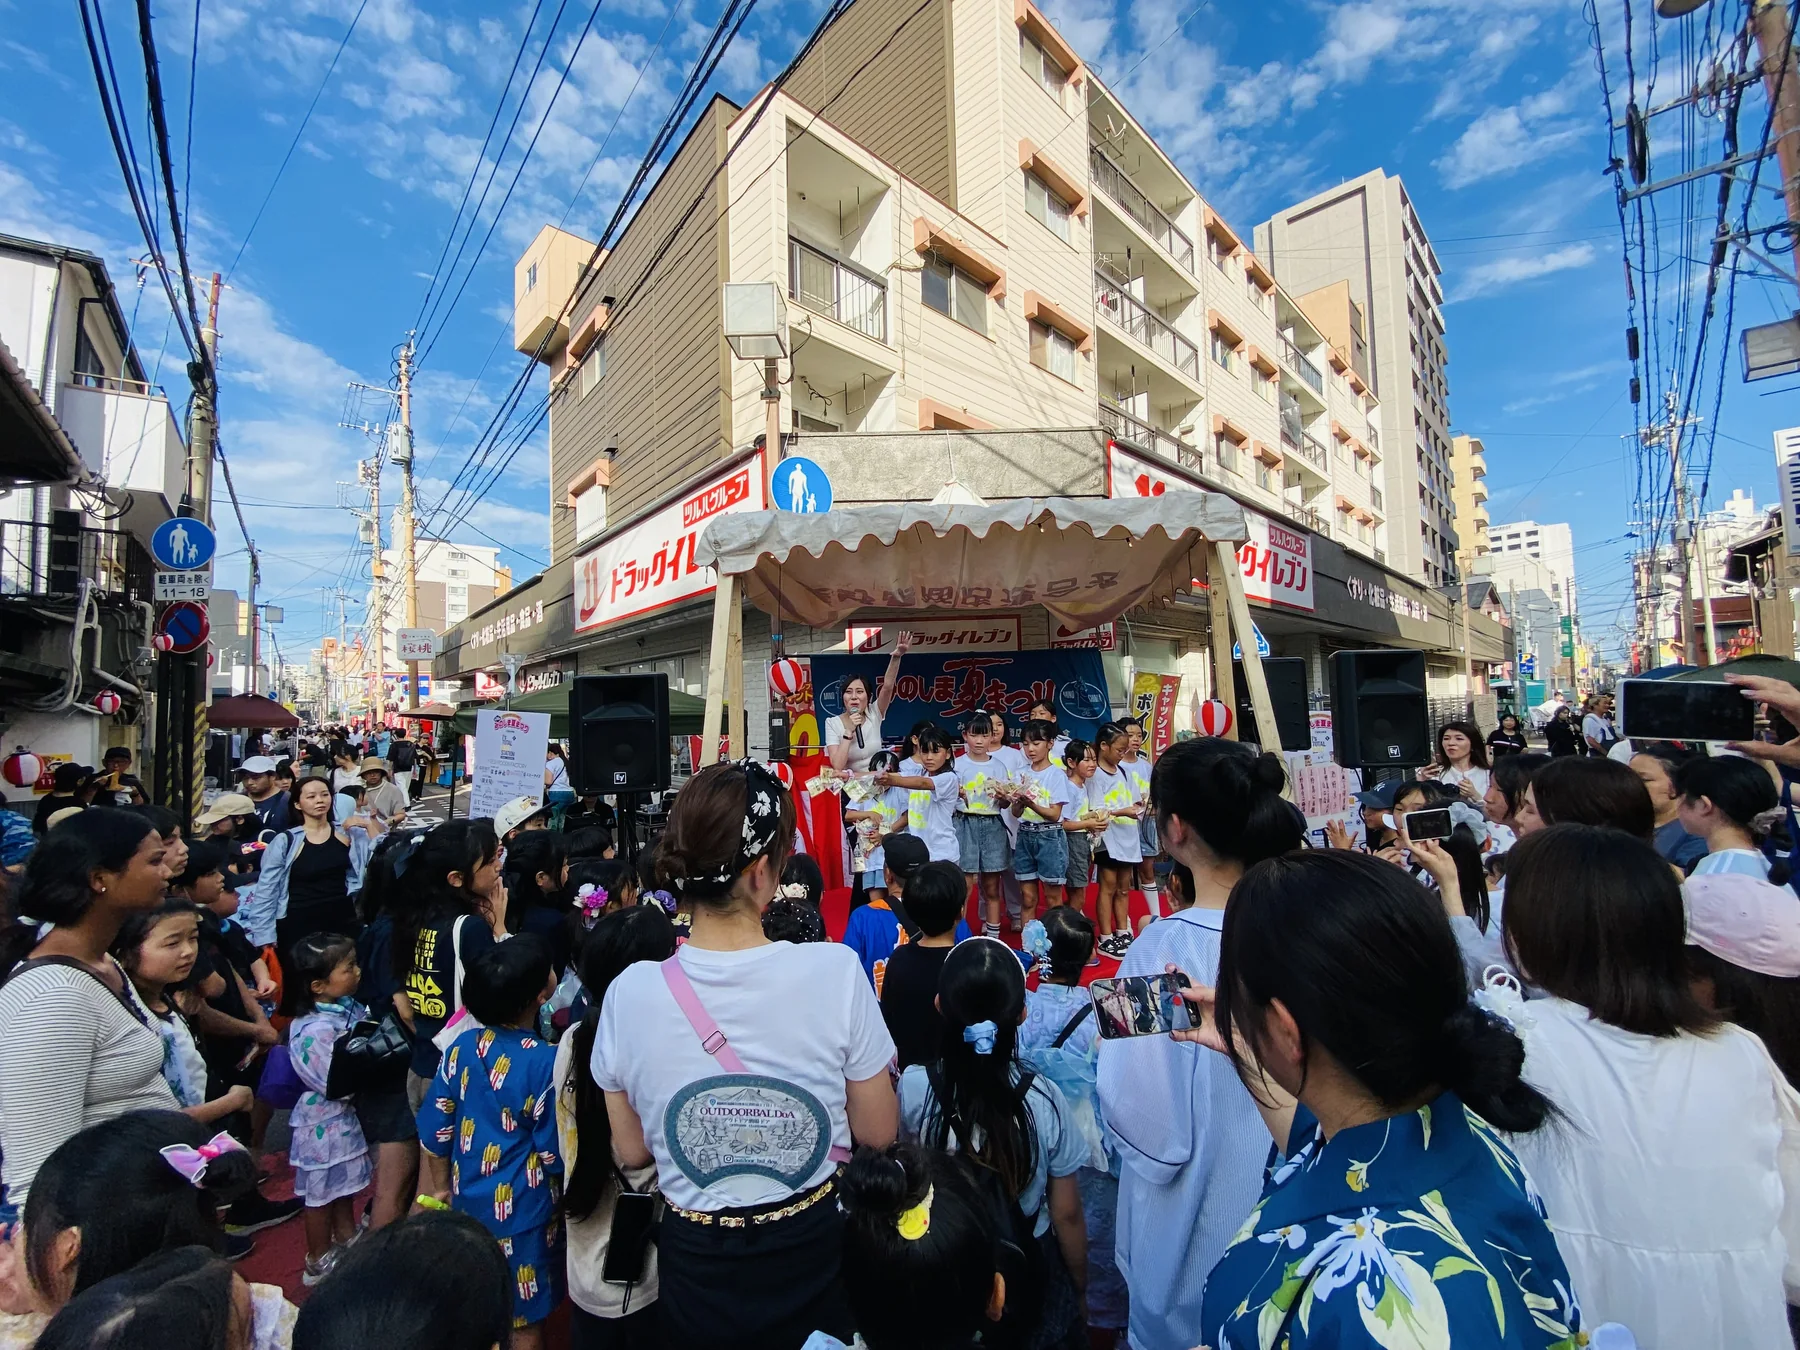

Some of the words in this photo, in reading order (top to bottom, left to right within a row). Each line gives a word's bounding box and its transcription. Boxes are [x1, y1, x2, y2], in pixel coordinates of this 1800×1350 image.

[684, 475, 747, 523] ツルハグループ
[1270, 526, 1306, 554] ツルハグループ
[158, 574, 210, 585] 軽車両を除く
[611, 531, 700, 604] ドラッグイレ
[401, 642, 432, 654] 桜桃
[908, 629, 1012, 646] ラッグイレブン
[1156, 684, 1173, 756] キャッシュレ
